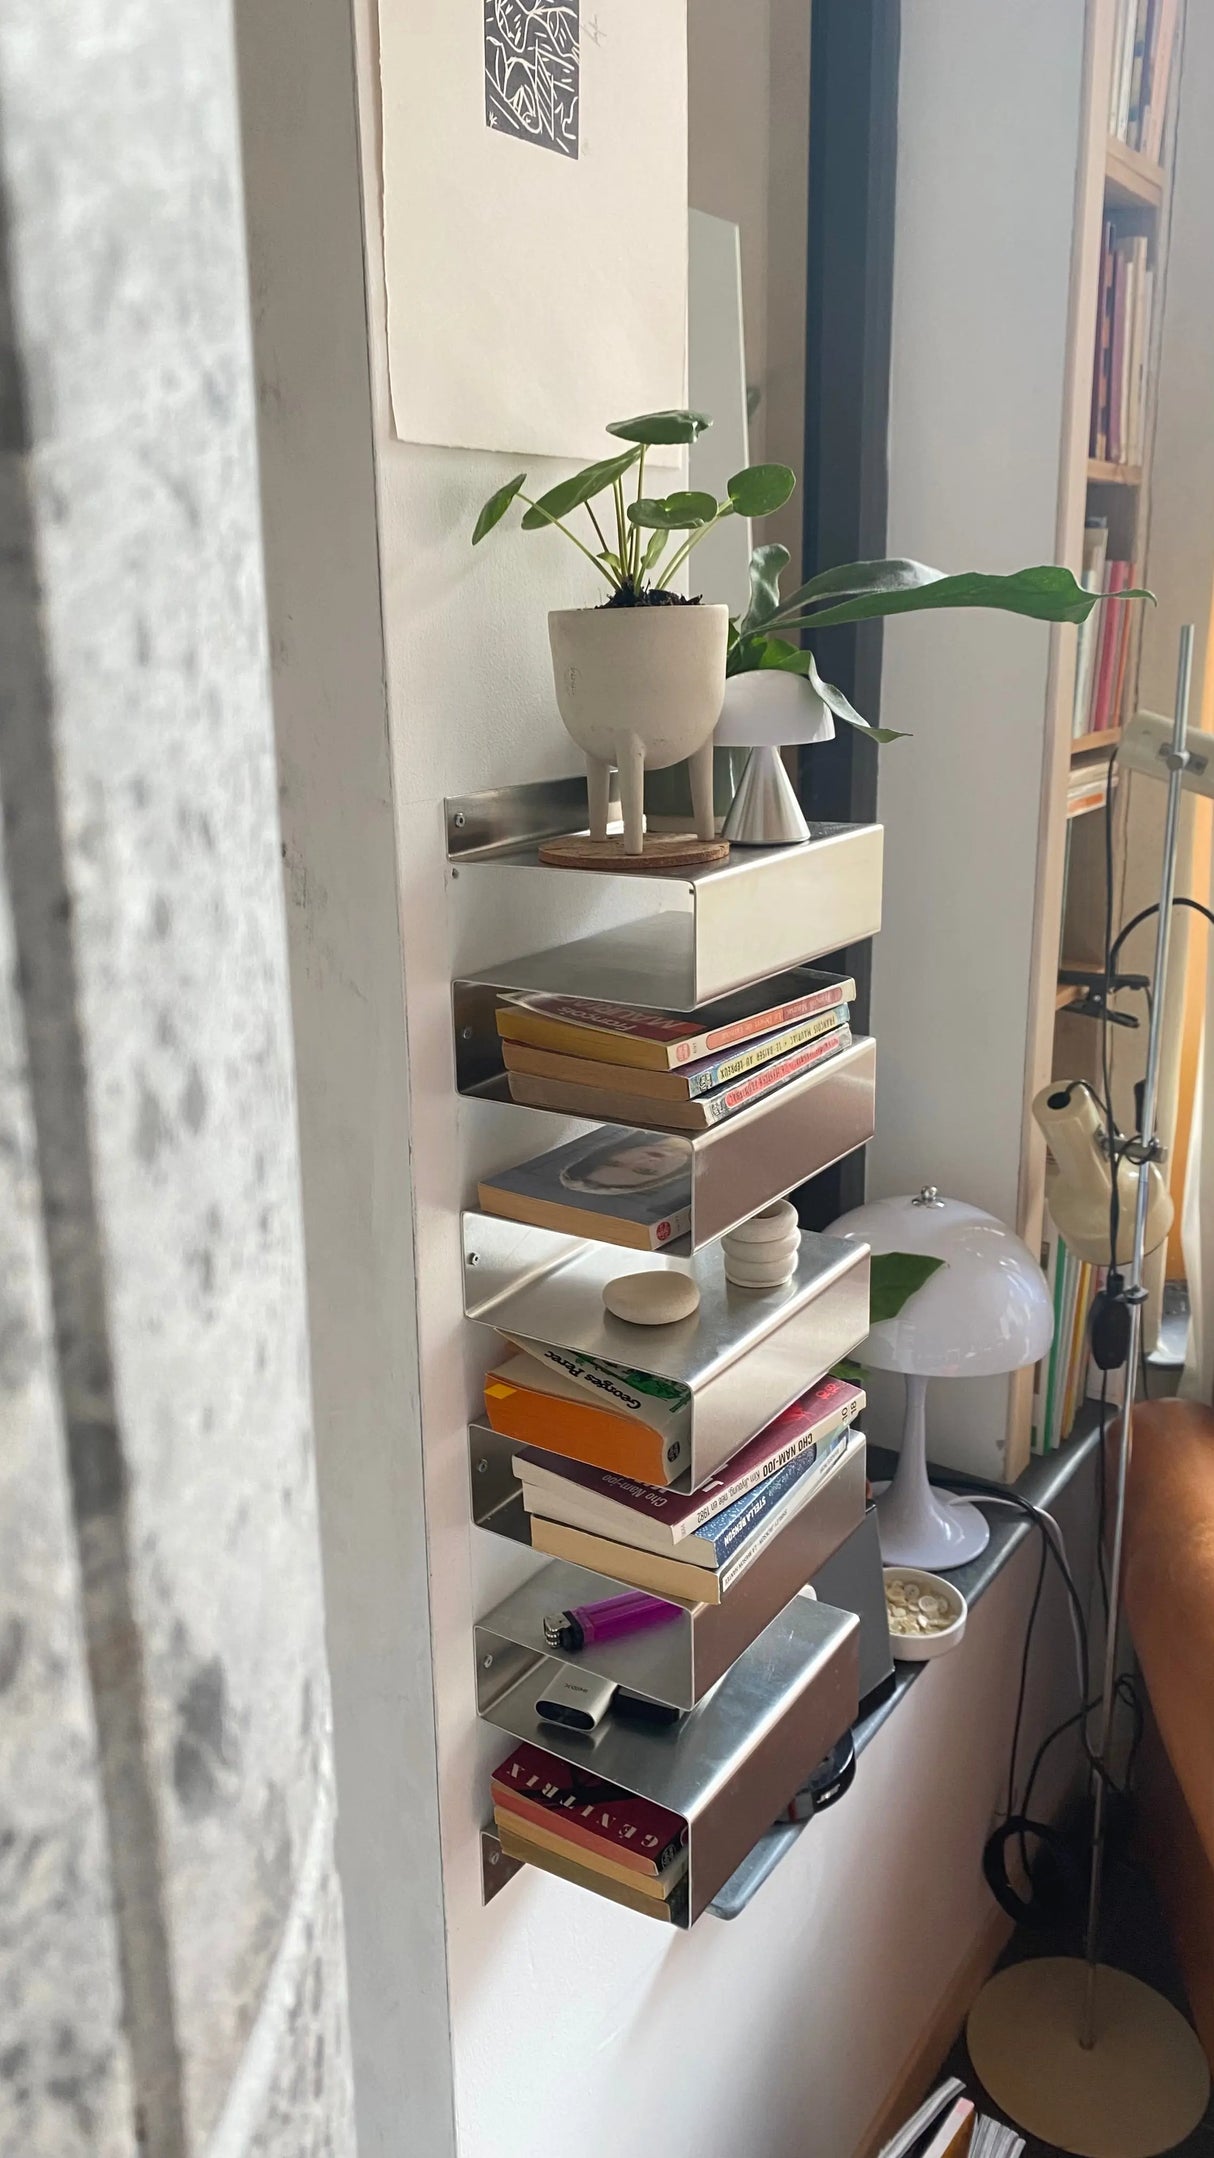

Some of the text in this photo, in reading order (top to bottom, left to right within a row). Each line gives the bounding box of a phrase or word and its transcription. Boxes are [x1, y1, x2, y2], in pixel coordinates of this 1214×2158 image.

[557, 1006, 638, 1032] François
[813, 1015, 836, 1032] FRANÇOIS
[790, 1029, 812, 1044] MAURIAC
[746, 1057, 753, 1067] AU
[756, 1046, 774, 1061] BAISER
[544, 1350, 641, 1410] Georges Perec
[850, 1400, 857, 1415] 18
[798, 1432, 813, 1452] CHO
[762, 1442, 797, 1477] NAM-JOO
[750, 1470, 761, 1481] Kim
[602, 1474, 645, 1498] Nam-joo
[645, 1490, 668, 1507] Cho
[710, 1499, 718, 1508] en
[718, 1494, 729, 1506] née
[697, 1507, 711, 1523] 1982
[724, 1496, 767, 1547] STELLA BENSON
[506, 1763, 659, 1847] GÉNITRIX
